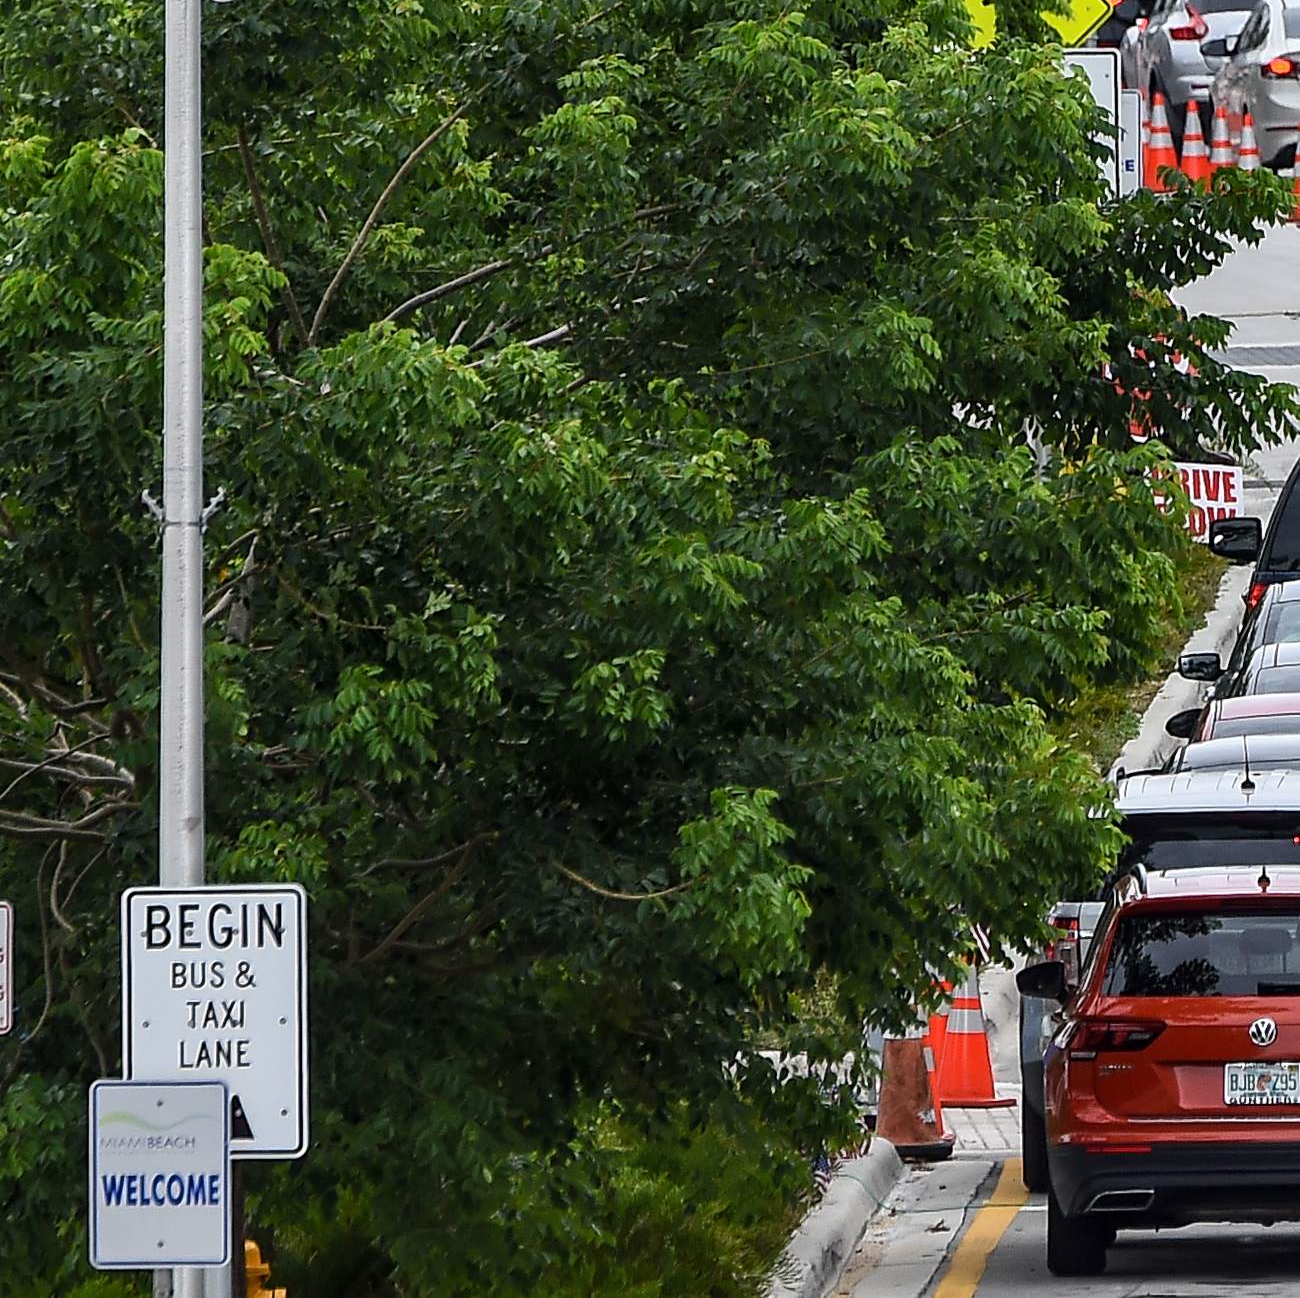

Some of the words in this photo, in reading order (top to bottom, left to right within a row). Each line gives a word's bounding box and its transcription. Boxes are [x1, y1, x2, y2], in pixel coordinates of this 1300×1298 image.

[1152, 467, 1237, 503] RIVE
[145, 903, 284, 949] BEGIN
[171, 961, 225, 988] BUS
[235, 961, 256, 988] &
[187, 1001, 245, 1028] TAXI
[179, 1041, 251, 1069] LANE
[102, 1174, 219, 1206] WELCOME
